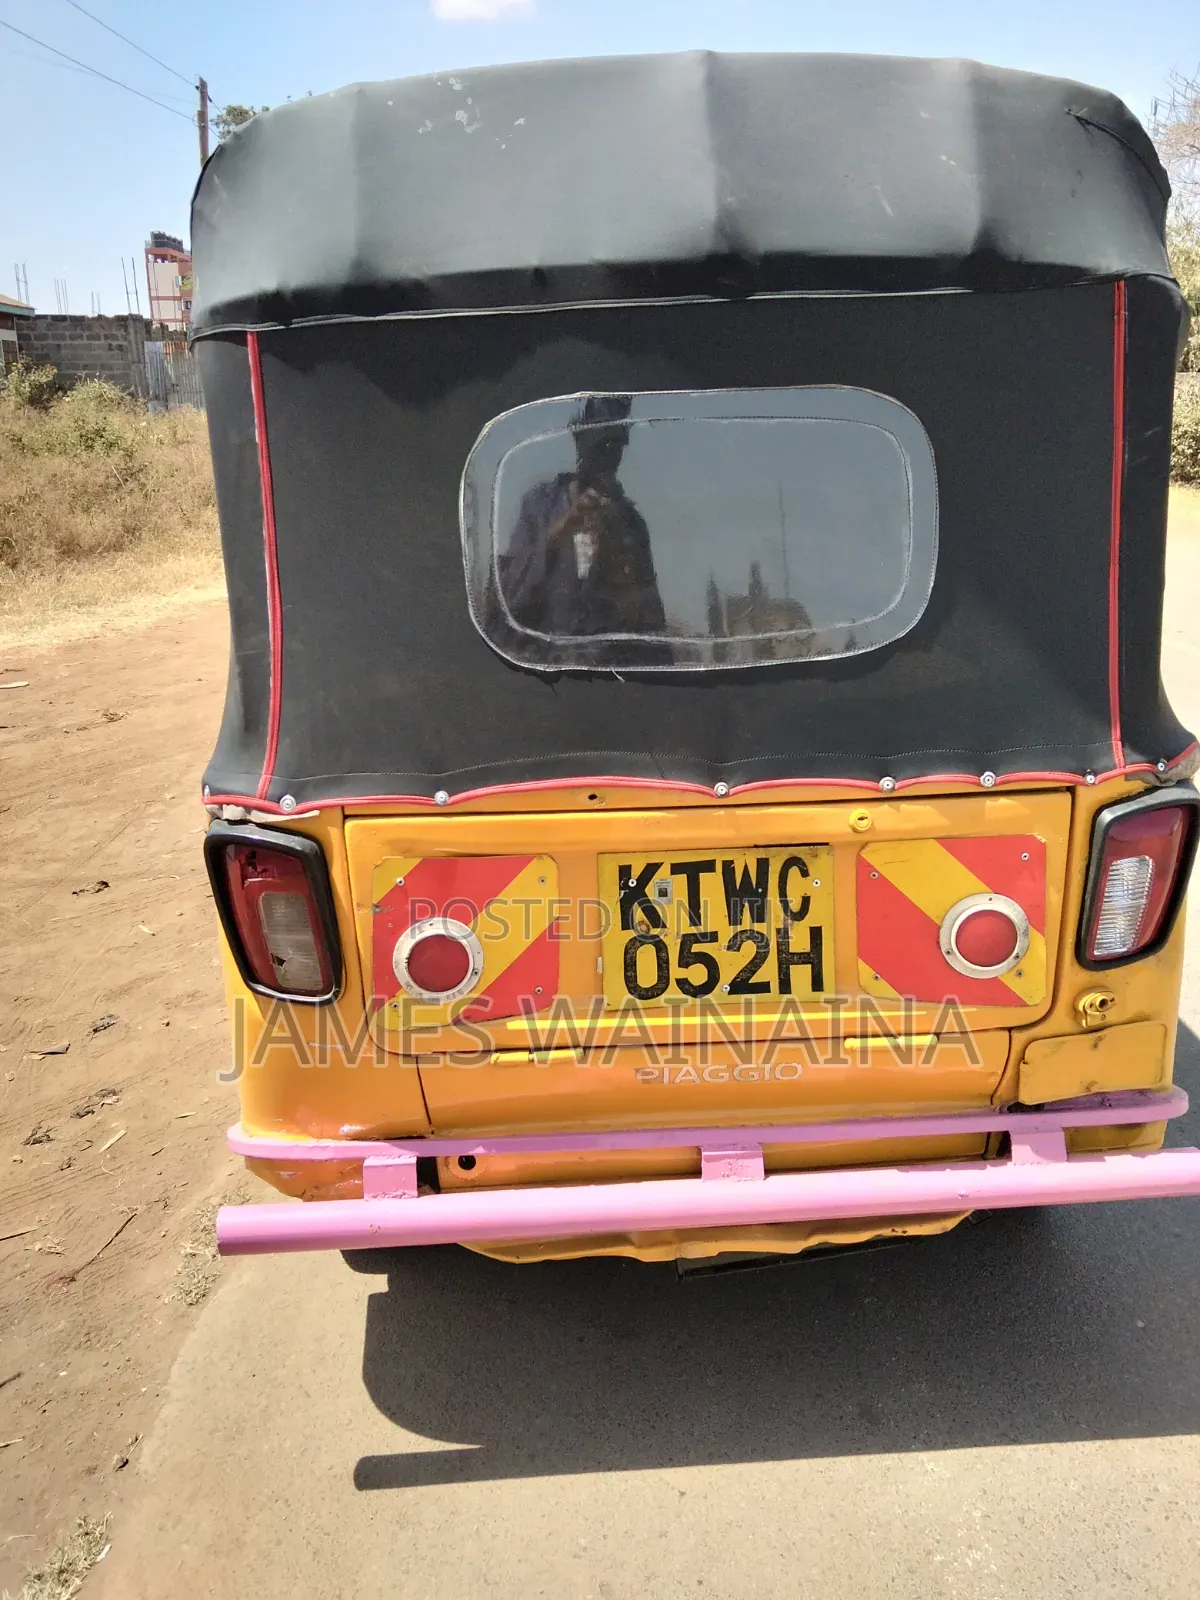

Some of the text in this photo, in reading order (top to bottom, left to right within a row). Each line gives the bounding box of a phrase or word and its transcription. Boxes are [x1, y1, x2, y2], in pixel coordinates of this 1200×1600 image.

[619, 856, 811, 930] KTWC
[623, 926, 824, 1000] 052H
[637, 1062, 804, 1085] PIAGGIO
